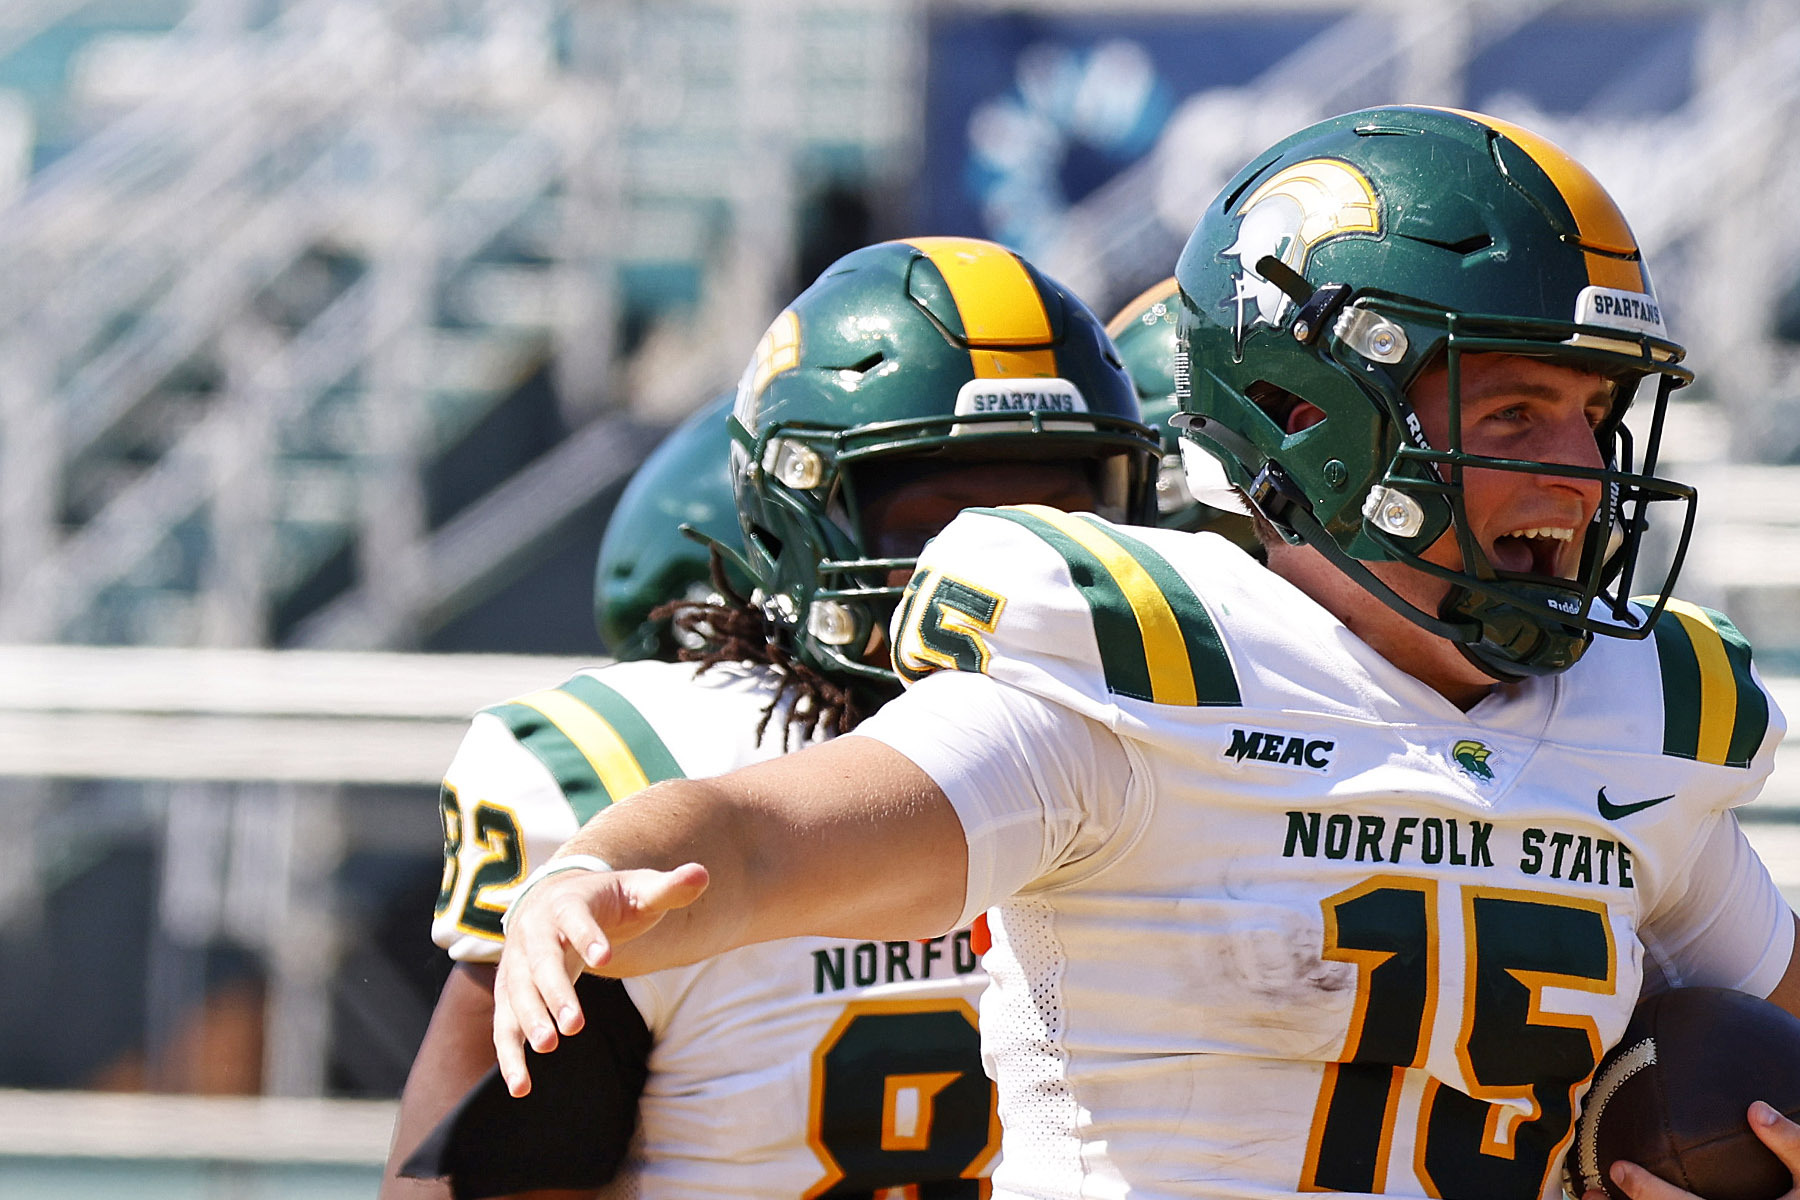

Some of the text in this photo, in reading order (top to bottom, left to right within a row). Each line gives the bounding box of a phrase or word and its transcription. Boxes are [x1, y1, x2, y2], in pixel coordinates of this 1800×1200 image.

[1594, 295, 1660, 325] SPARTANS
[974, 392, 1073, 412] SPARTANS
[1224, 729, 1334, 770] MEAC
[1283, 811, 1634, 888] NORFOLK STATE
